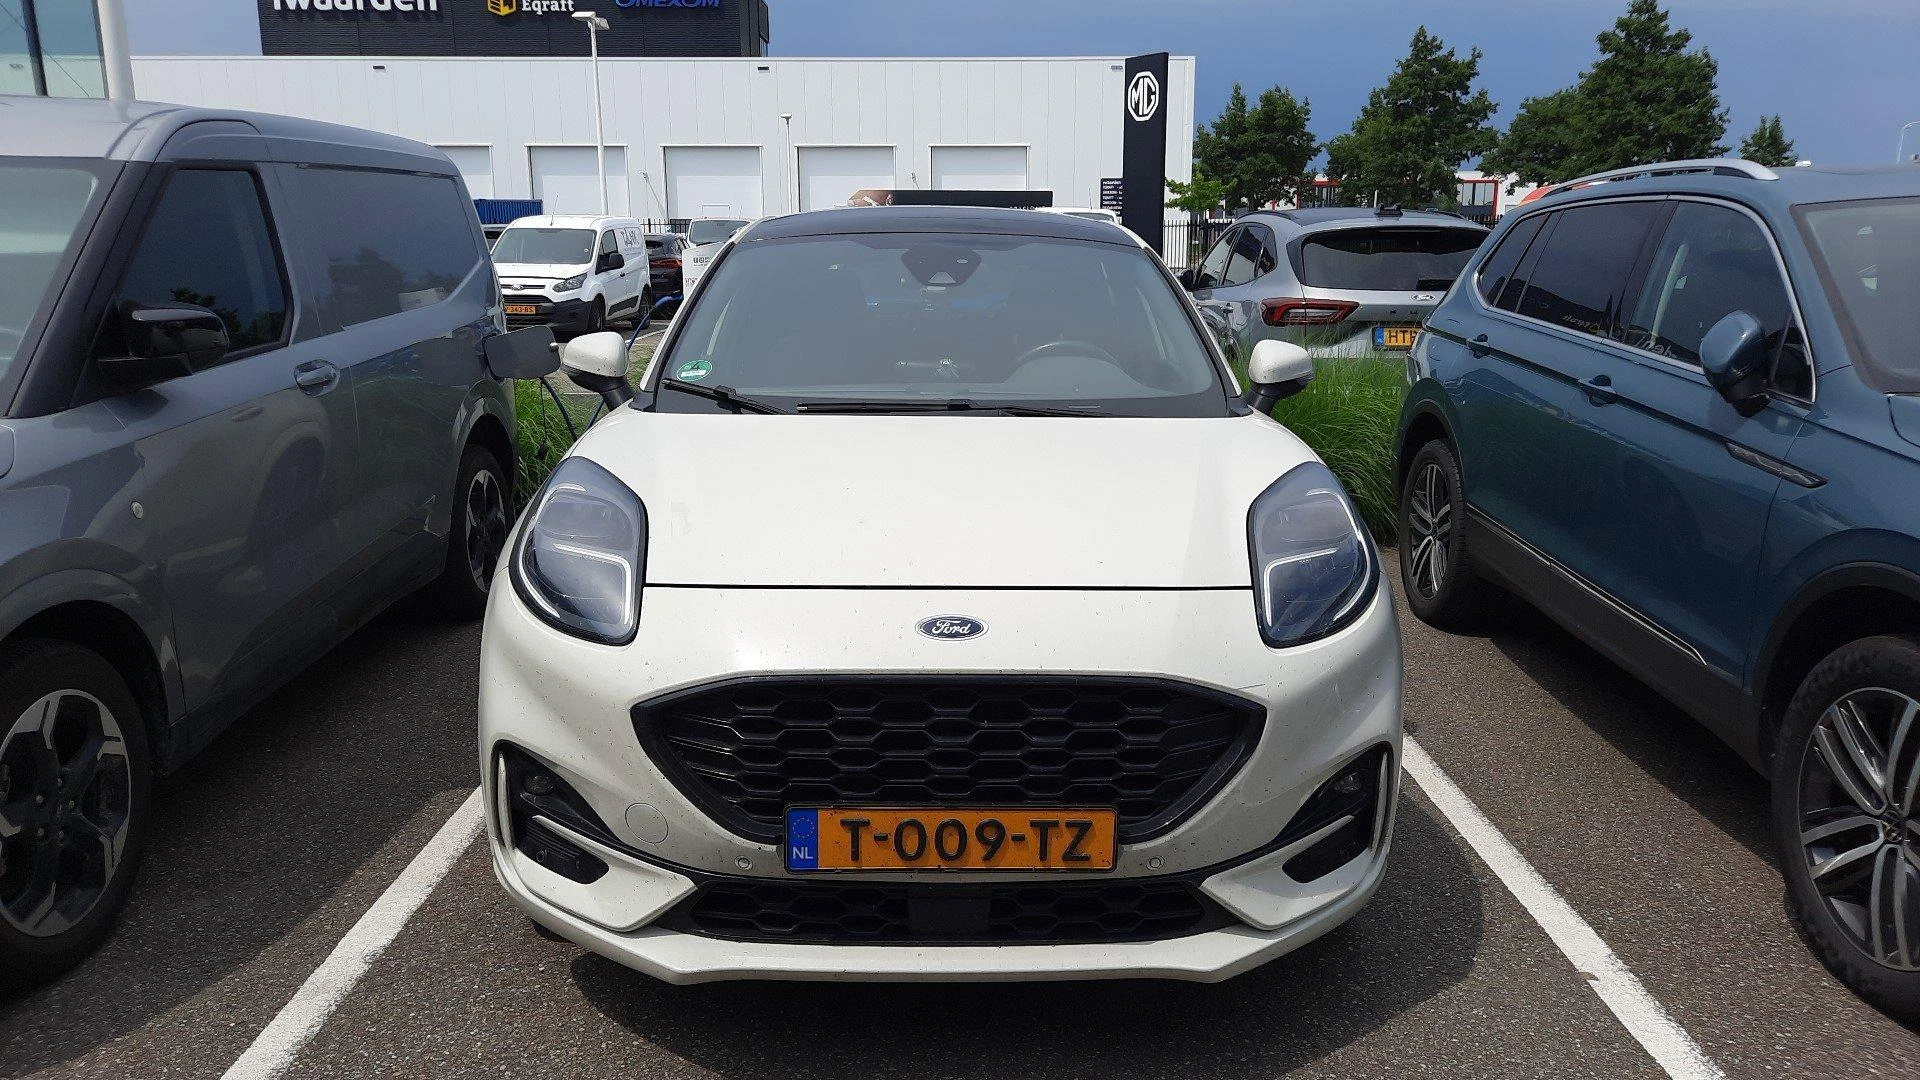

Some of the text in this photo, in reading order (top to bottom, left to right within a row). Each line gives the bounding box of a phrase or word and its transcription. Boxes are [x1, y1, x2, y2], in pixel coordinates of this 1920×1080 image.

[521, 0, 575, 15] Eqraft
[1131, 77, 1156, 116] MG
[931, 620, 971, 634] Ford
[792, 818, 1094, 862] NL T-009-TZ
